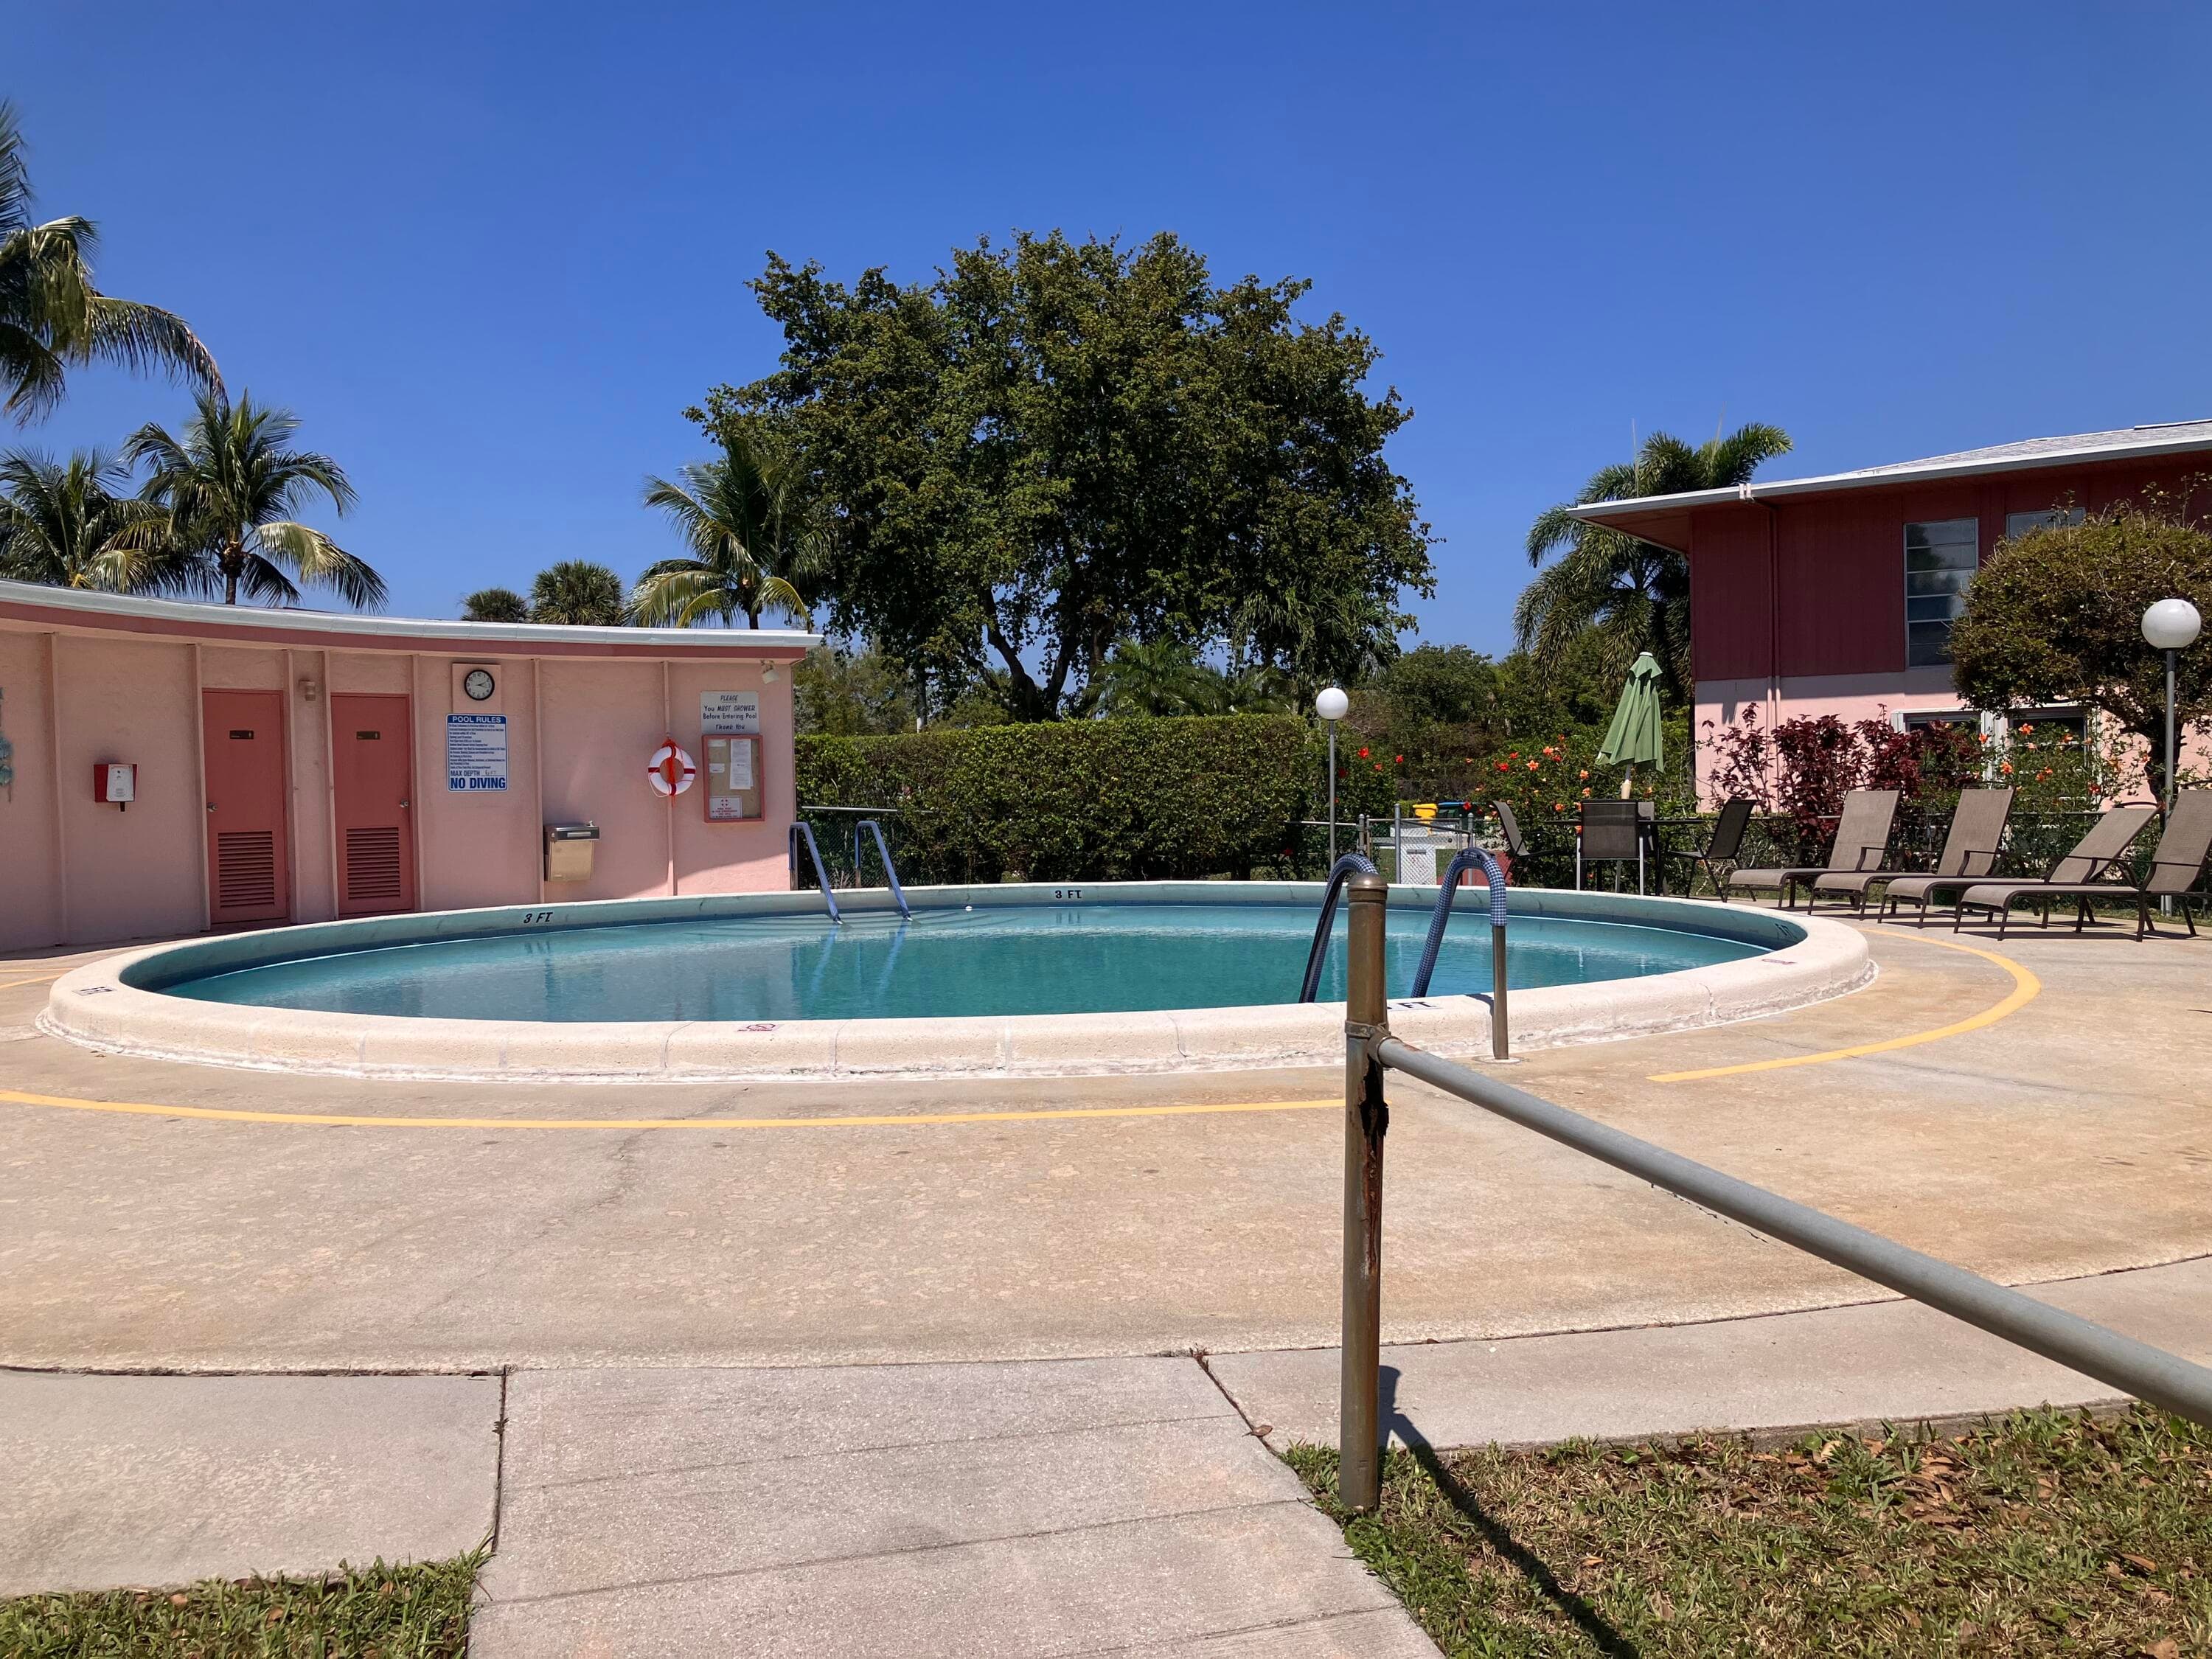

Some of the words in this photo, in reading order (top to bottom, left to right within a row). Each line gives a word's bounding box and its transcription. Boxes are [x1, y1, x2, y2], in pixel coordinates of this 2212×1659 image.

[451, 777, 466, 789] NO
[470, 777, 506, 789] DIVING
[1054, 890, 1062, 899] 3
[523, 913, 533, 924] 3
